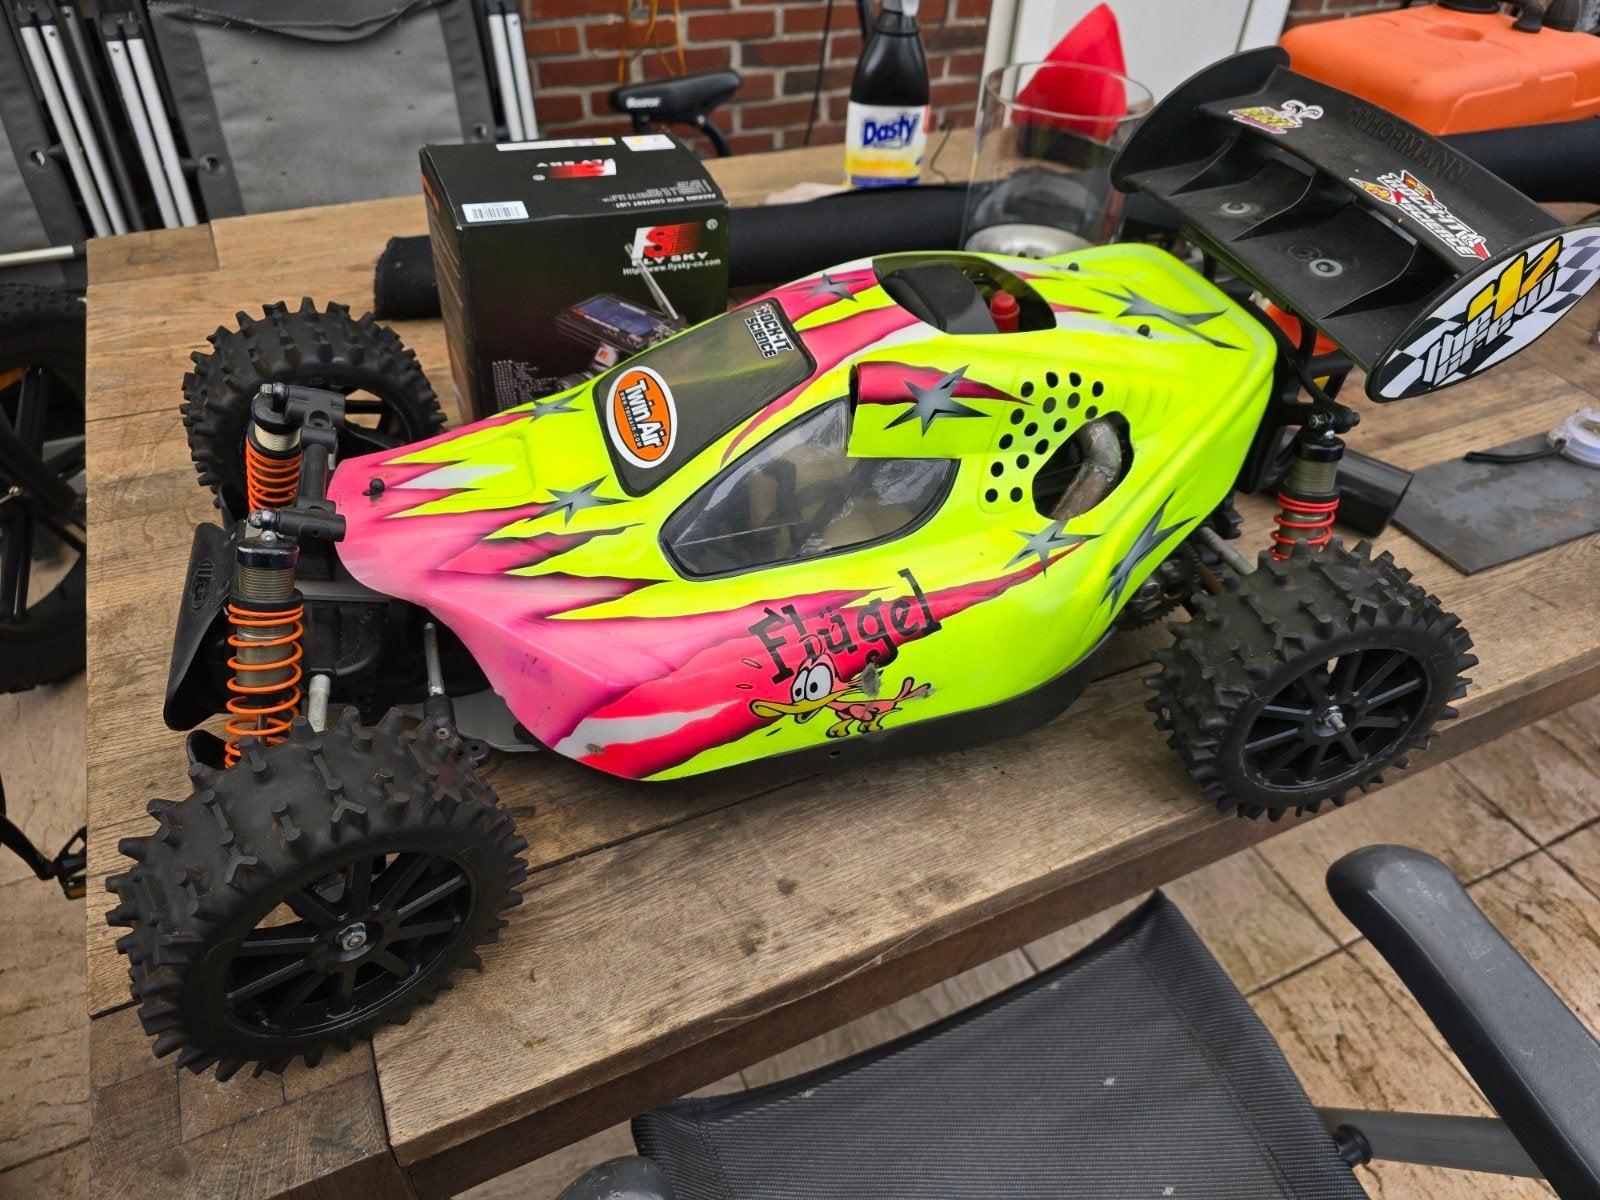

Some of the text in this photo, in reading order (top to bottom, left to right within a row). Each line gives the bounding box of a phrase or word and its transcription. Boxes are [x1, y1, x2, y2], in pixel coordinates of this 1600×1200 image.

[862, 113, 920, 147] Dasty
[670, 251, 709, 263] SKY
[745, 315, 778, 358] SCIENCE
[748, 568, 943, 685] Flügel
